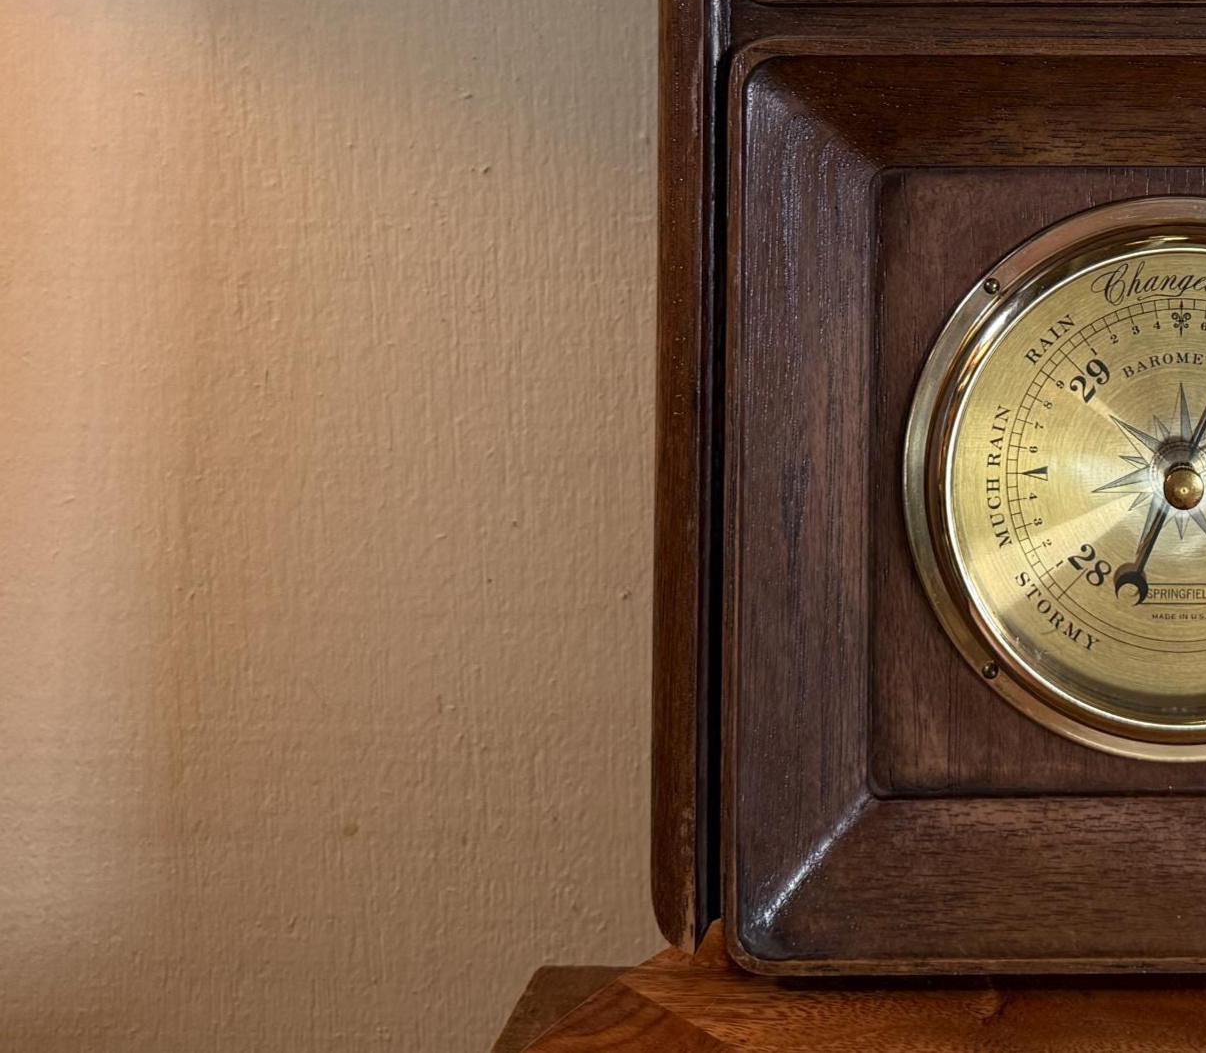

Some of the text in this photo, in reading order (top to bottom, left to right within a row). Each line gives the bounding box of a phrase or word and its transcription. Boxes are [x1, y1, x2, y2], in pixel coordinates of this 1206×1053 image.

[1110, 334, 1119, 344] 2
[1131, 326, 1140, 335] 3
[1153, 321, 1161, 330] 4
[1024, 314, 1075, 365] RAIN
[1070, 359, 1110, 403] 29
[986, 404, 1012, 547] MUCH RAIN
[1029, 492, 1038, 500] 4
[1034, 518, 1043, 527] 3
[1067, 543, 1112, 587] 28
[1015, 571, 1100, 651] STORMY
